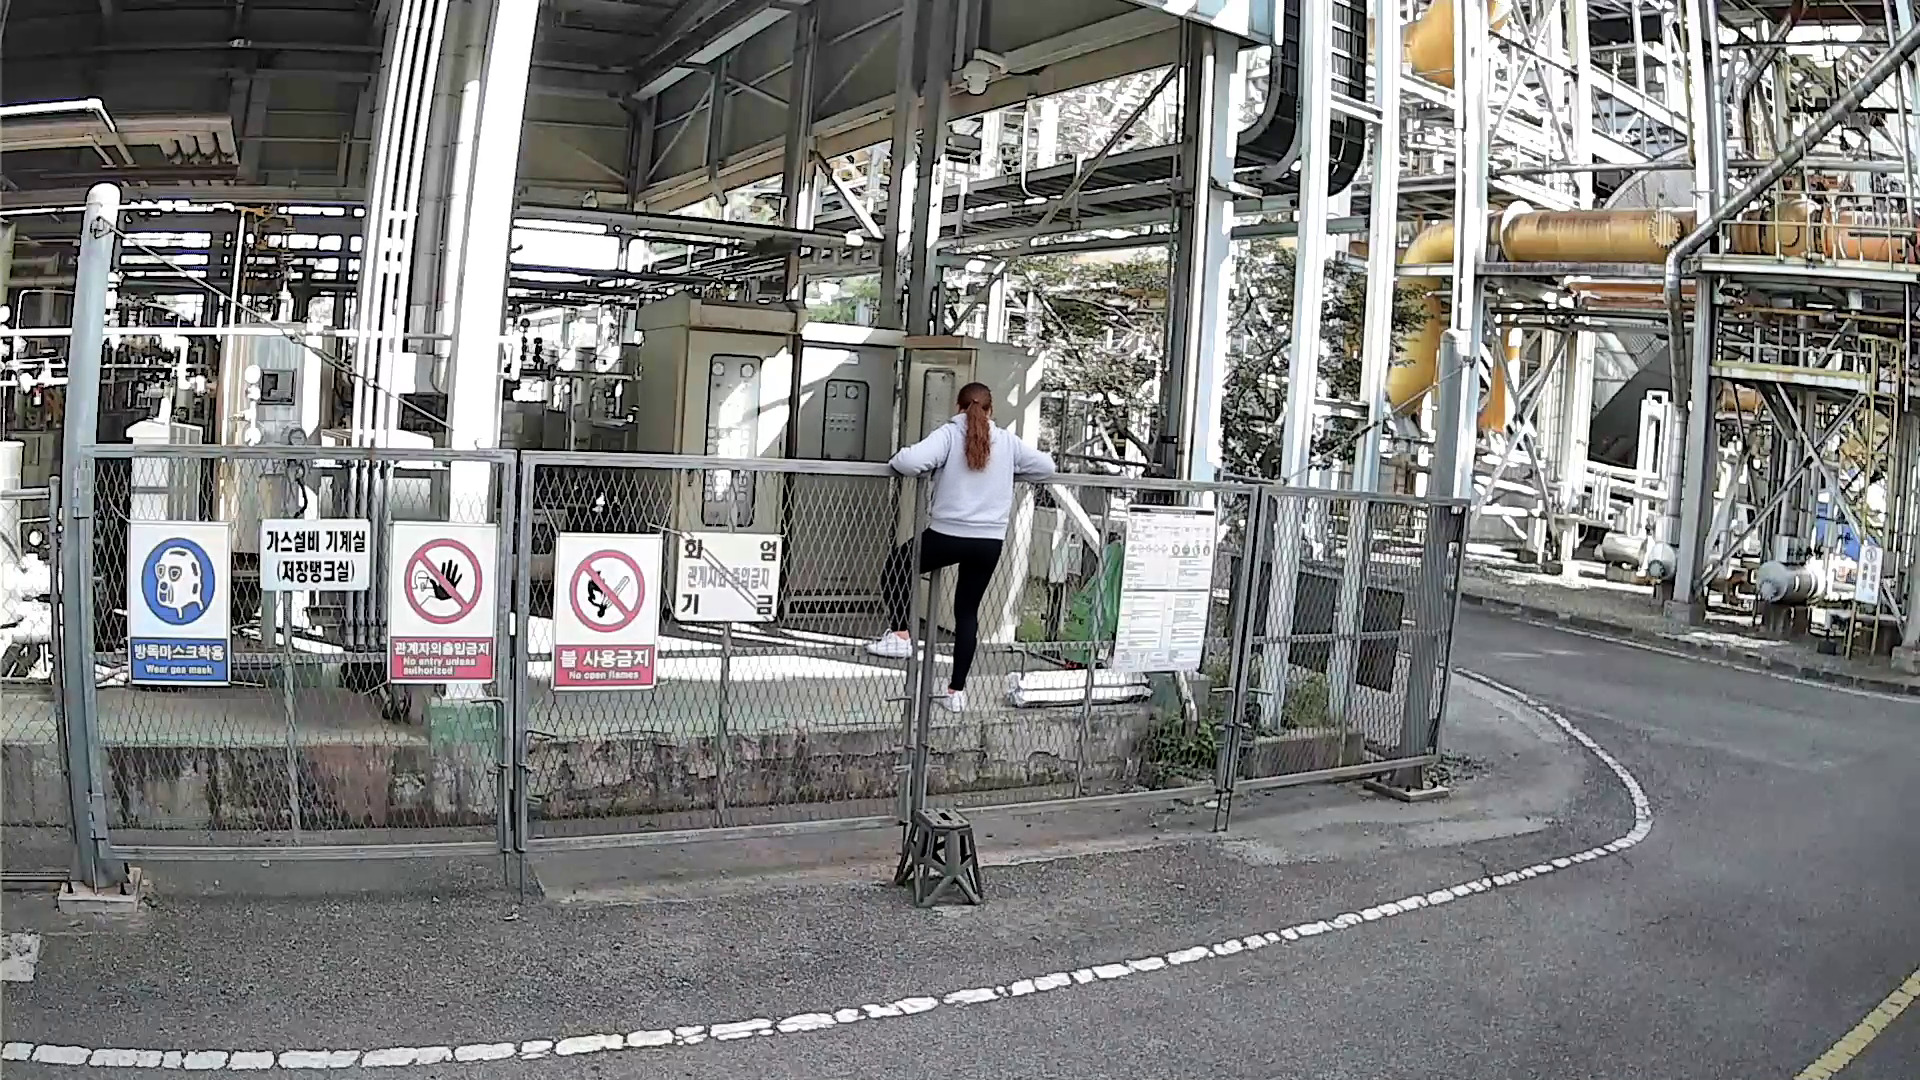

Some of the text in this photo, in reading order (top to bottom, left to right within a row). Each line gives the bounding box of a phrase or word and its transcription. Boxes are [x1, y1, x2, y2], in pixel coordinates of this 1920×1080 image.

[266, 530, 366, 553] 가스설비 기계실
[684, 539, 778, 562] 화 엄
[276, 560, 355, 583] (저장탱크실)
[681, 593, 773, 615] 기 금
[134, 643, 225, 661] 방독마스크착용
[403, 656, 416, 666] No
[418, 657, 443, 667] entry
[560, 648, 650, 668] 불 사용금지
[146, 664, 168, 674] Wear
[403, 666, 453, 676] authorized
[569, 671, 639, 681] No open flames
